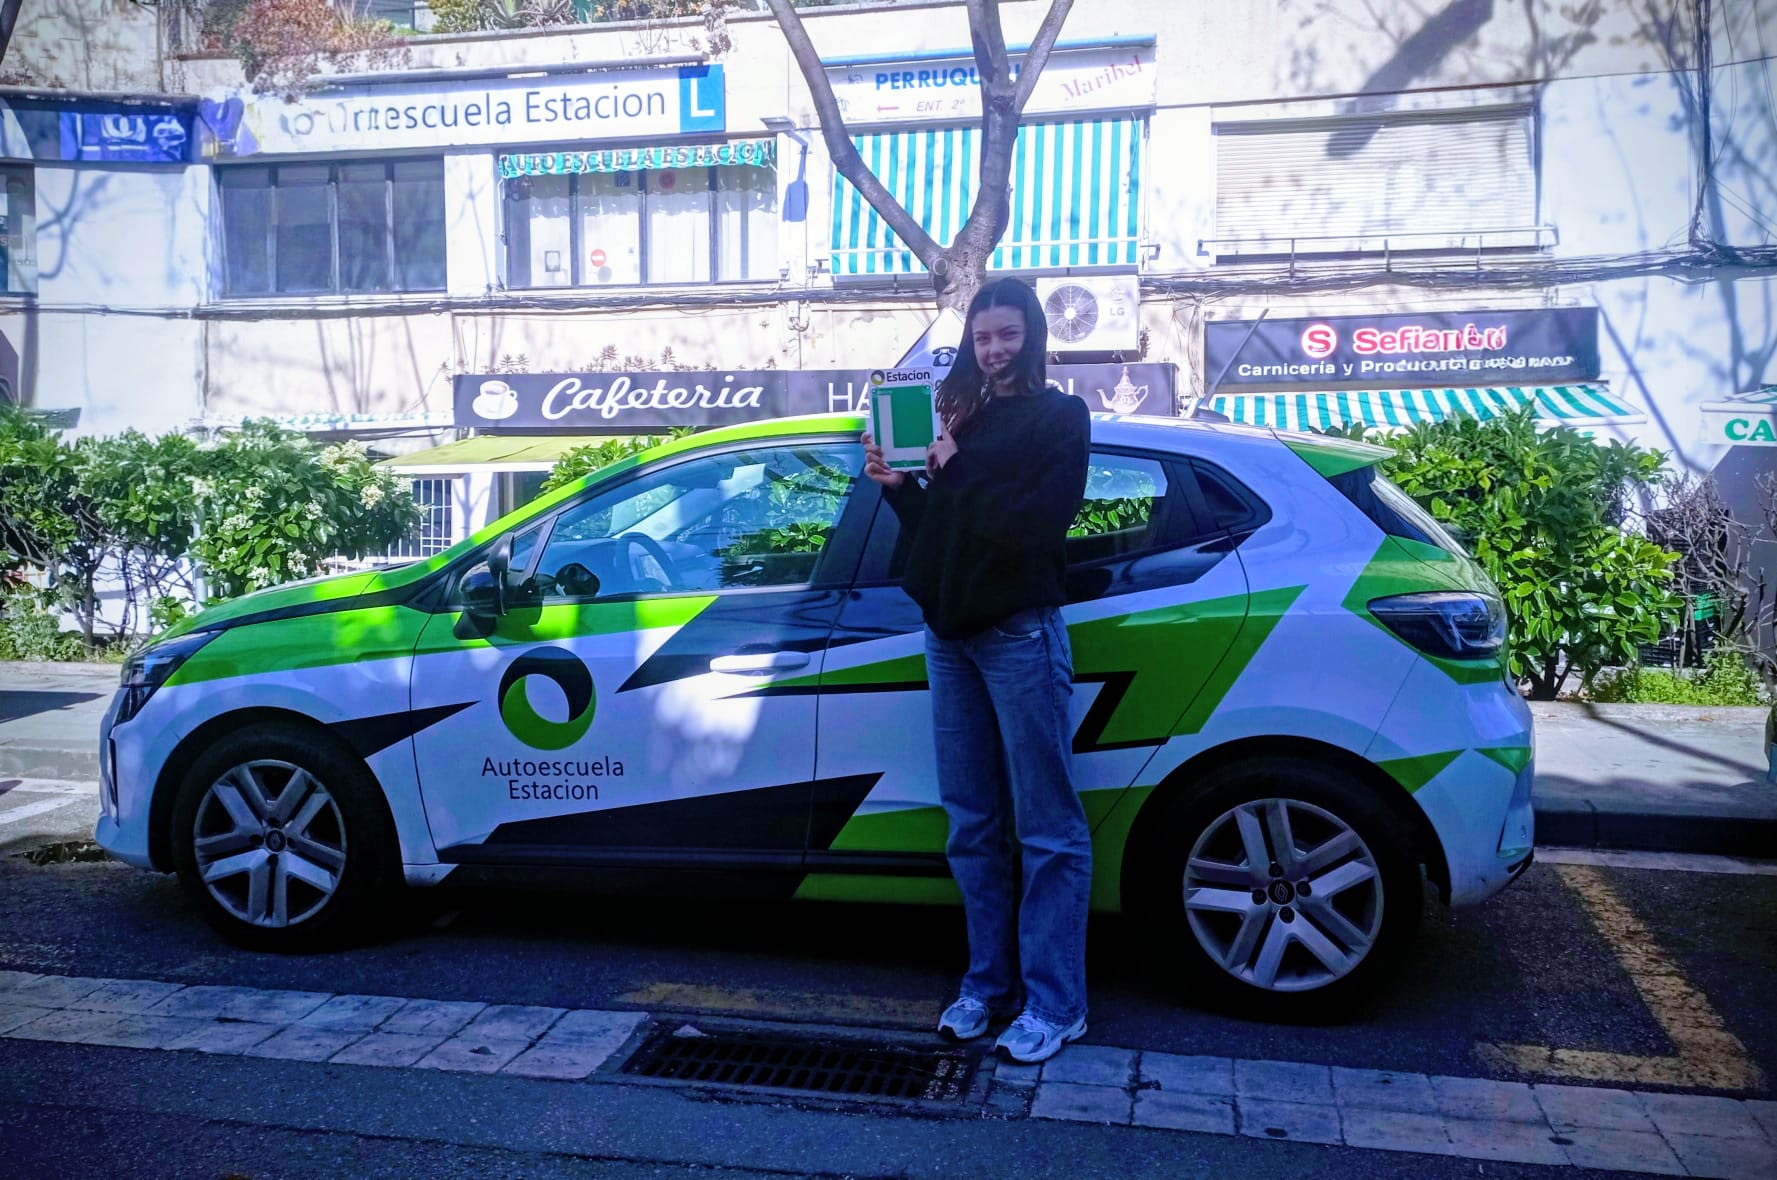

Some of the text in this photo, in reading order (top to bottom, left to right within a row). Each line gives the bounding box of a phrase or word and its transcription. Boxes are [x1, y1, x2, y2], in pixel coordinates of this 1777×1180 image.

[876, 64, 1021, 91] PERRUQUI
[326, 78, 715, 132] escuela Estacion L
[504, 140, 771, 174] AUTO ESCUELA ESTACION
[1109, 307, 1126, 317] LG
[886, 370, 931, 382] Estacion
[1238, 361, 1336, 376] Carnicería
[1342, 363, 1354, 375] y
[541, 375, 764, 420] Cafeteria
[481, 755, 624, 777] Autoescuela
[508, 779, 599, 800] Estacion
